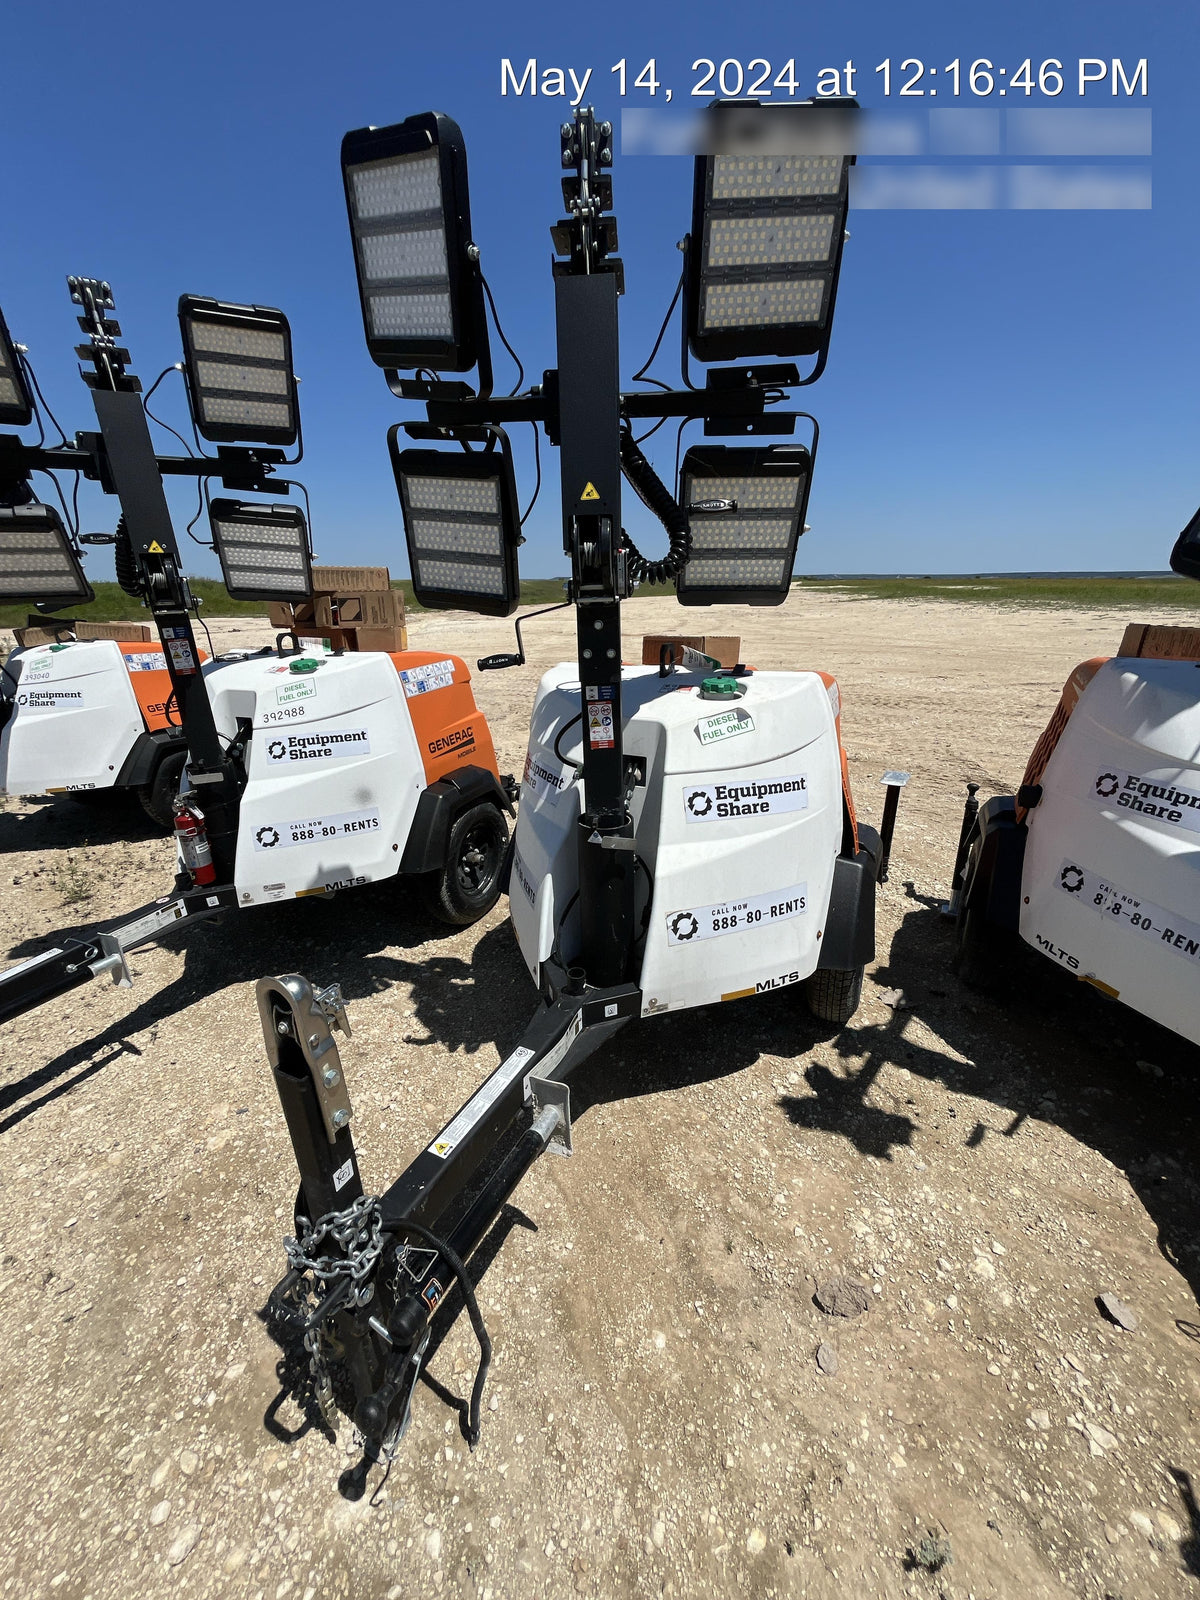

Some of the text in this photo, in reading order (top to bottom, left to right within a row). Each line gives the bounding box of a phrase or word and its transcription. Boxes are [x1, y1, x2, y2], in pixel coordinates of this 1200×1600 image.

[24, 672, 50, 681] 393040
[284, 682, 306, 693] DIESEL
[29, 691, 82, 701] Equipment
[279, 688, 314, 703] FUEL ONLY
[146, 701, 179, 714] GENE
[263, 706, 305, 724] 392988
[707, 713, 739, 728] DIESEL
[702, 720, 750, 741] FUEL ONLY
[288, 730, 368, 748] Equipment
[428, 727, 474, 754] GENERAC
[289, 748, 333, 760] Share
[457, 746, 476, 760] MOBILE
[66, 783, 96, 791] MLTS
[715, 777, 806, 801] Equipment
[1123, 775, 1200, 809] Equip
[717, 801, 769, 817] Share
[1117, 792, 1182, 822] Share
[292, 818, 379, 841] 888-80-RENTS
[325, 876, 366, 891] MLTS
[711, 903, 748, 916] CALL NOW
[1121, 895, 1141, 909] NOW
[712, 897, 806, 931] 888-80-RENTS
[1036, 934, 1080, 969] MLTS
[756, 971, 799, 992] MLTS
